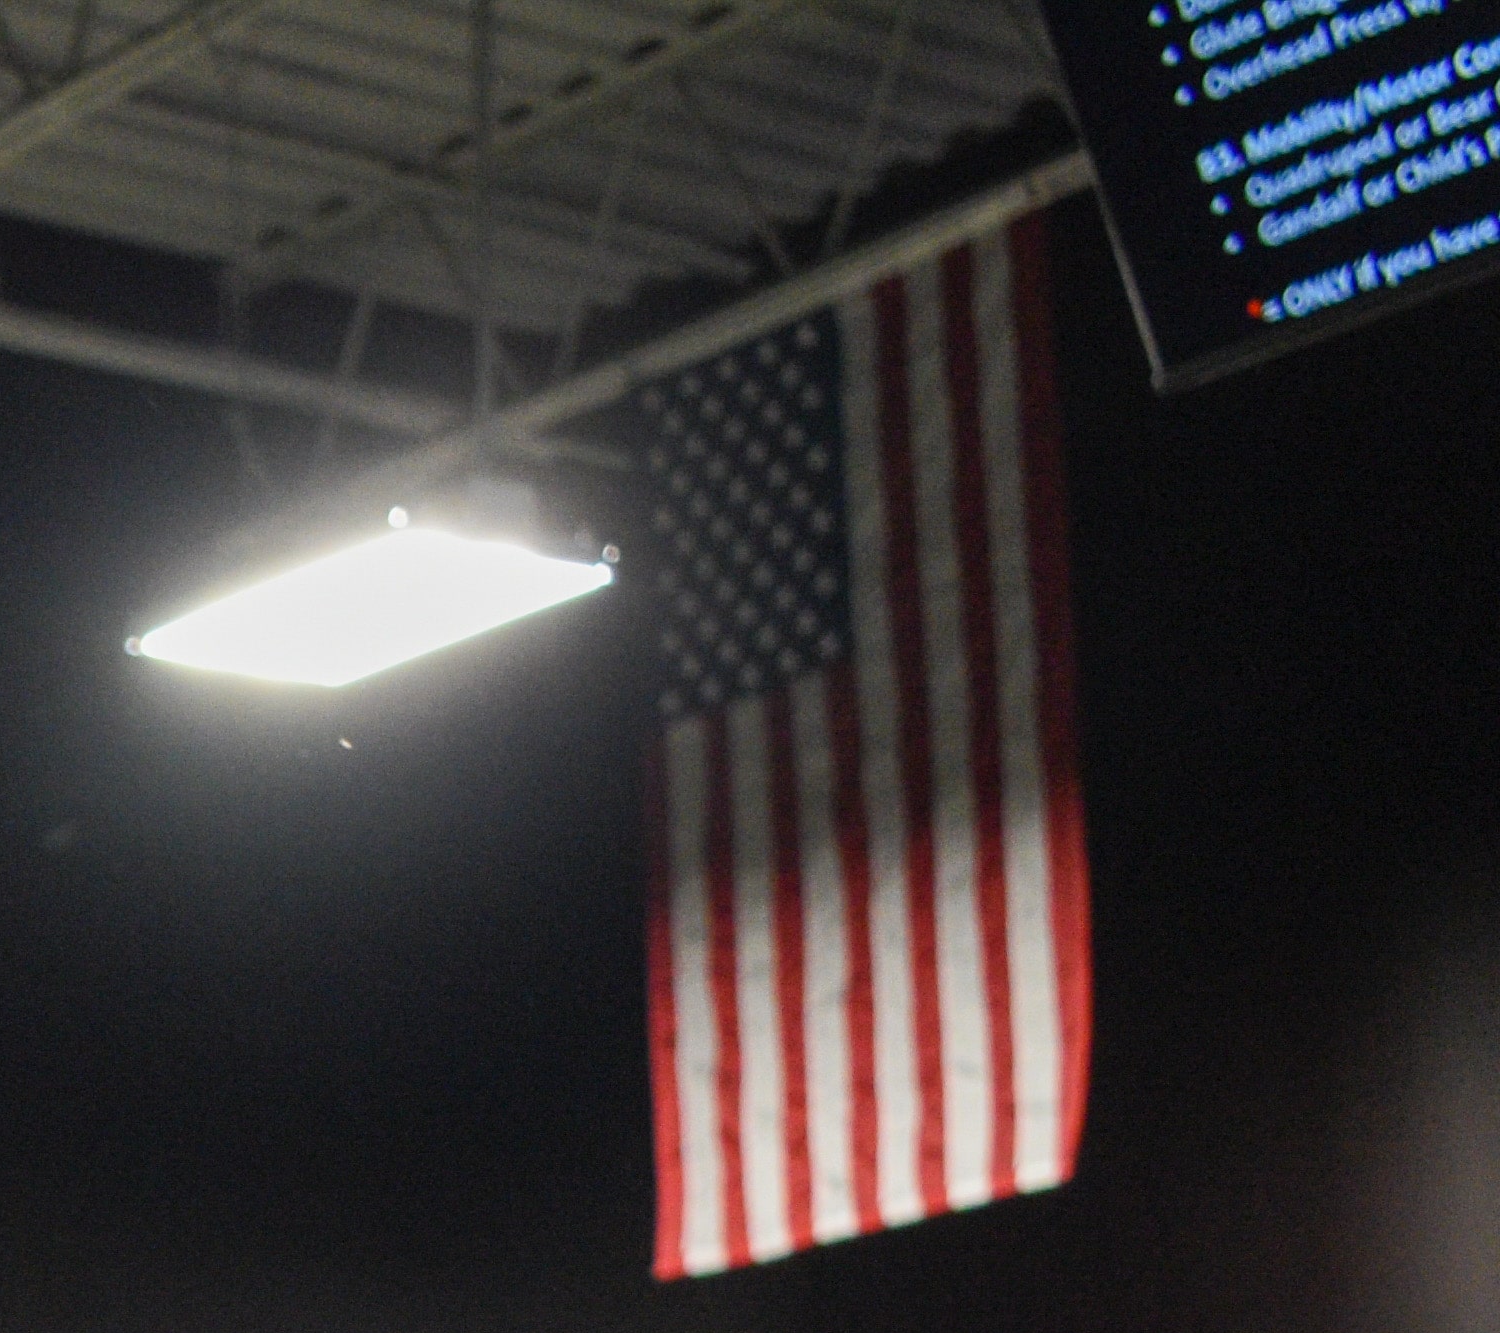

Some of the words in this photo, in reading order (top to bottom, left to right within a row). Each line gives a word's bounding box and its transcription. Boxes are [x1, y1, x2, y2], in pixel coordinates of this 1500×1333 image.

[1190, 11, 1266, 60] Glute
[1203, 20, 1334, 100] Overhead
[1330, 1, 1408, 49] Press
[1245, 121, 1397, 208] Quadruped
[1395, 113, 1430, 149] or
[1427, 87, 1496, 136] Bear
[1363, 171, 1398, 208] or
[1282, 261, 1357, 318] ONLY
[1353, 249, 1384, 291] if
[1377, 240, 1438, 287] you
[1429, 212, 1500, 263] have
